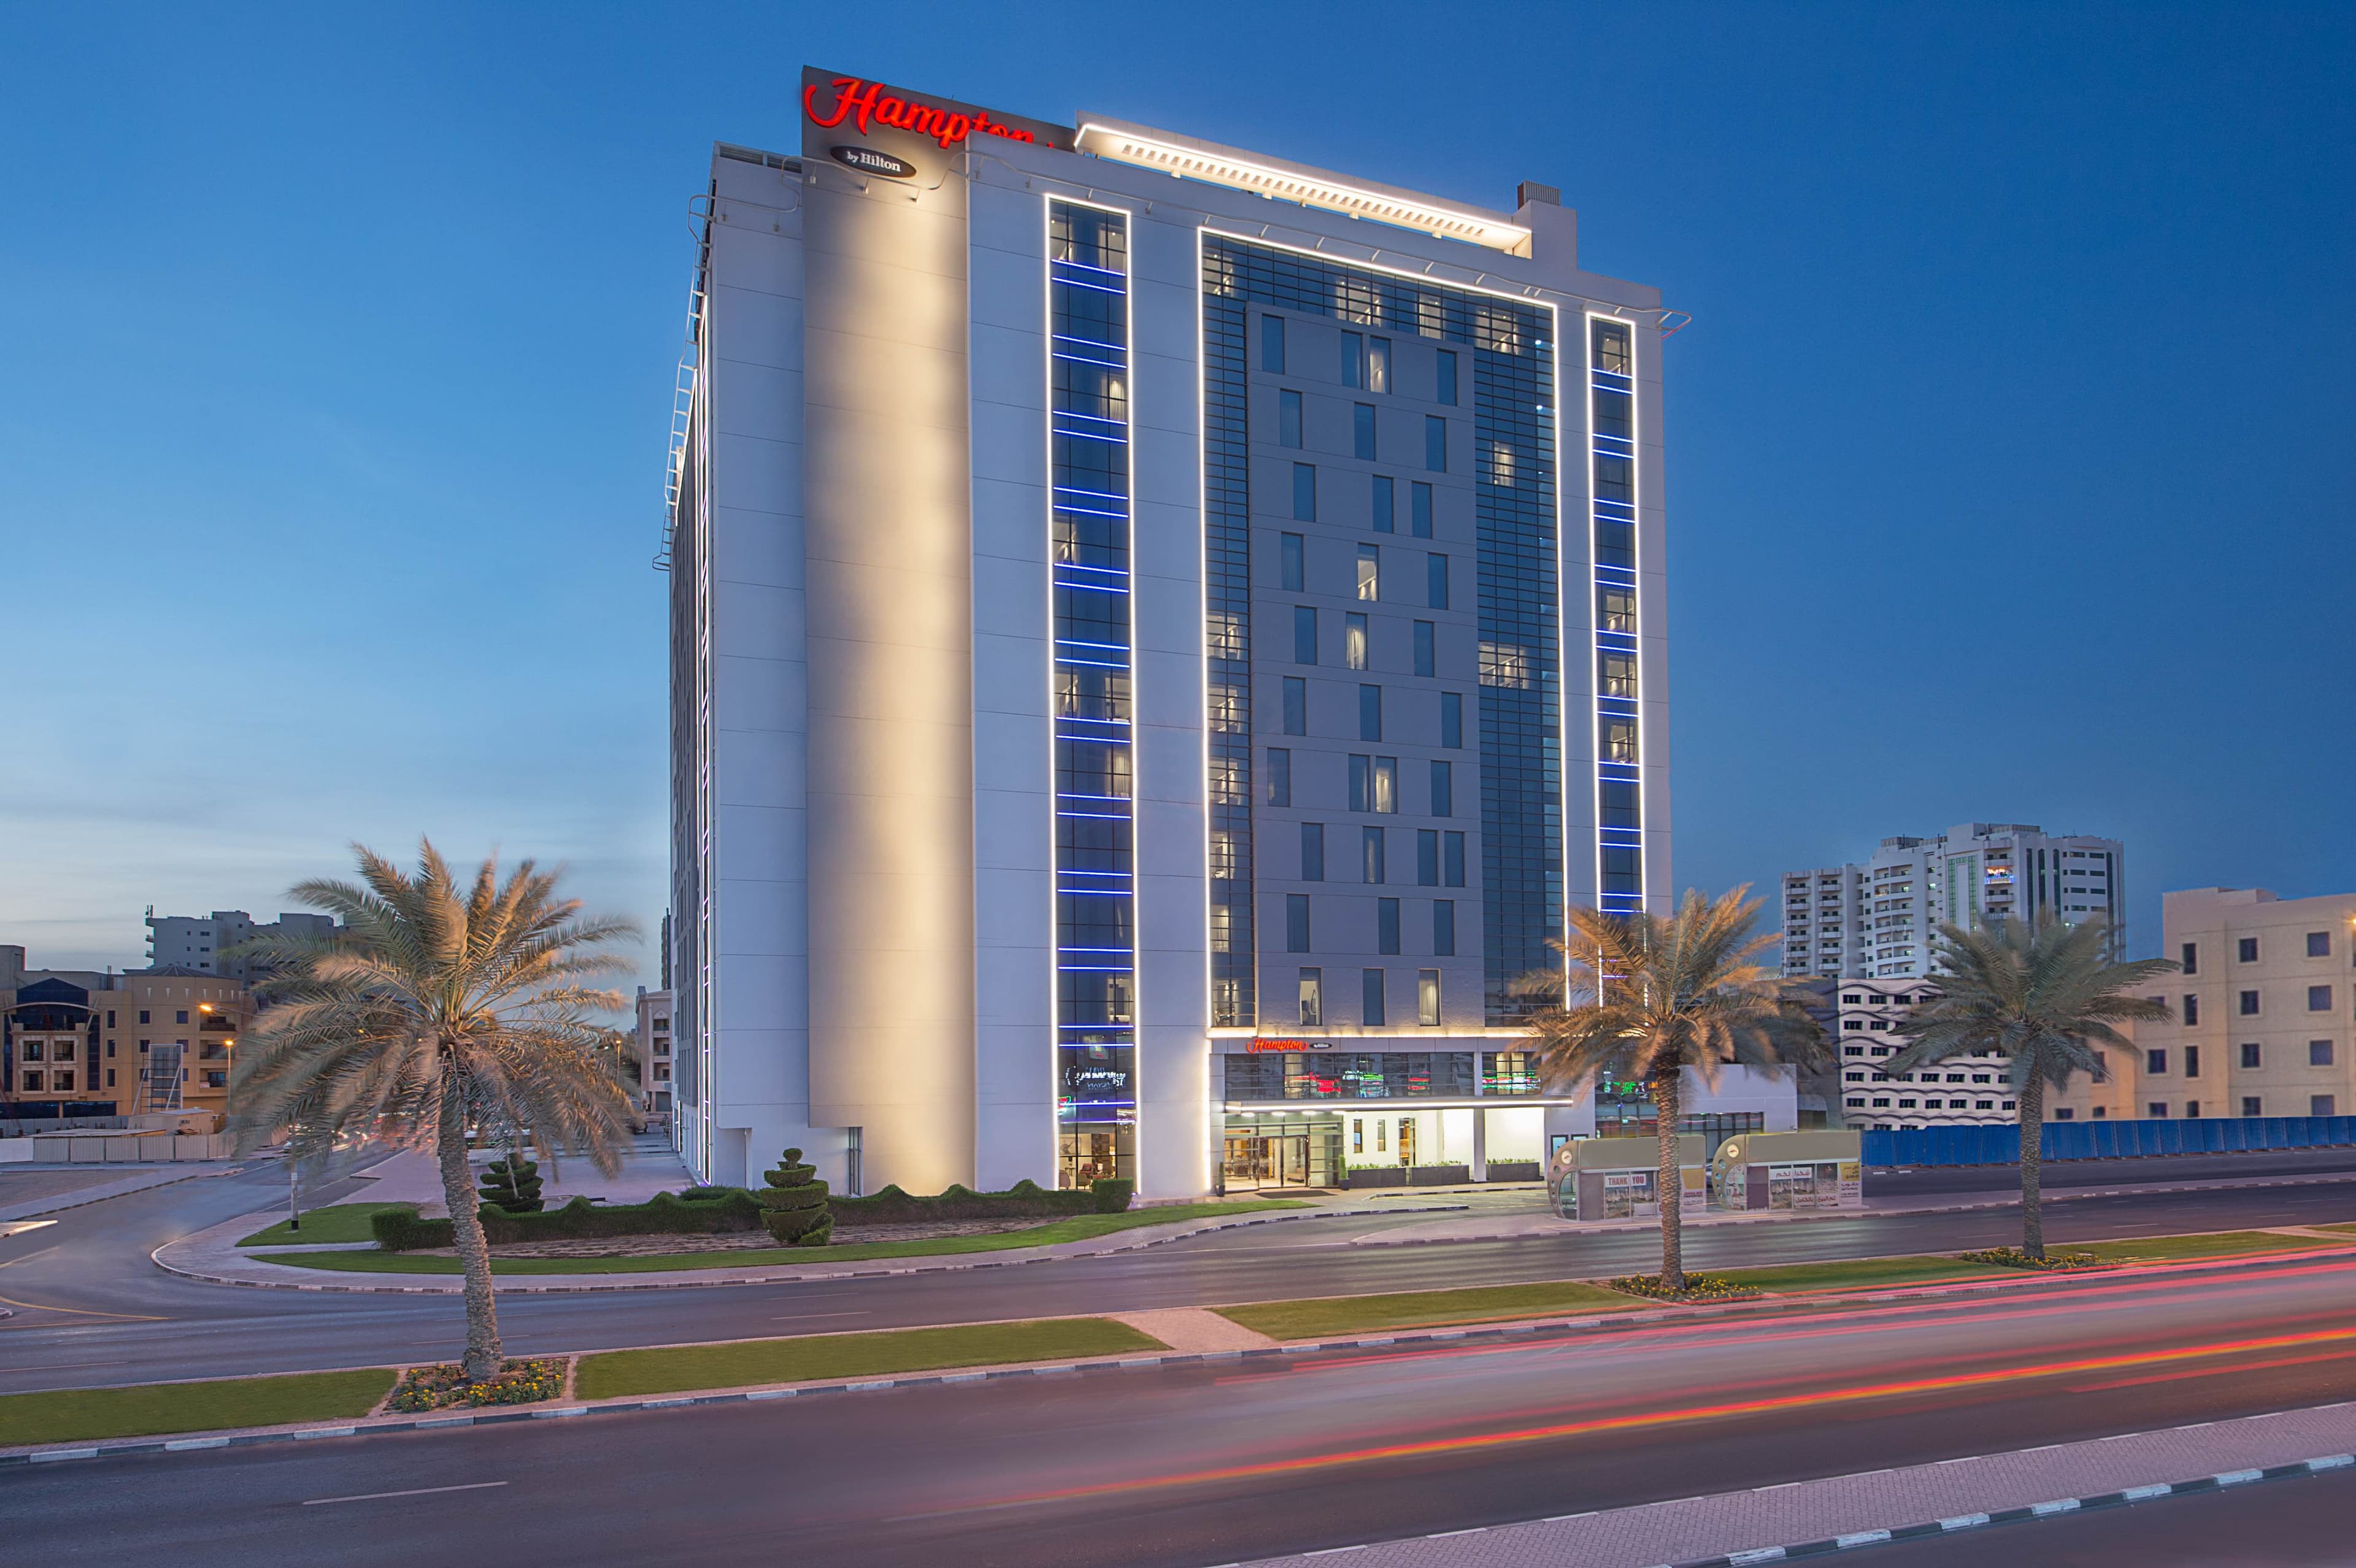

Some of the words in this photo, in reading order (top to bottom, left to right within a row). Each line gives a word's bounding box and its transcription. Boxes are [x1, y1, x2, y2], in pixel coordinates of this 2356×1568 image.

[847, 151, 858, 163] by
[860, 153, 901, 172] Hilton
[1246, 1037, 1309, 1054] Hampton
[1608, 1176, 1628, 1186] THANK
[1632, 1175, 1645, 1185] YOU
